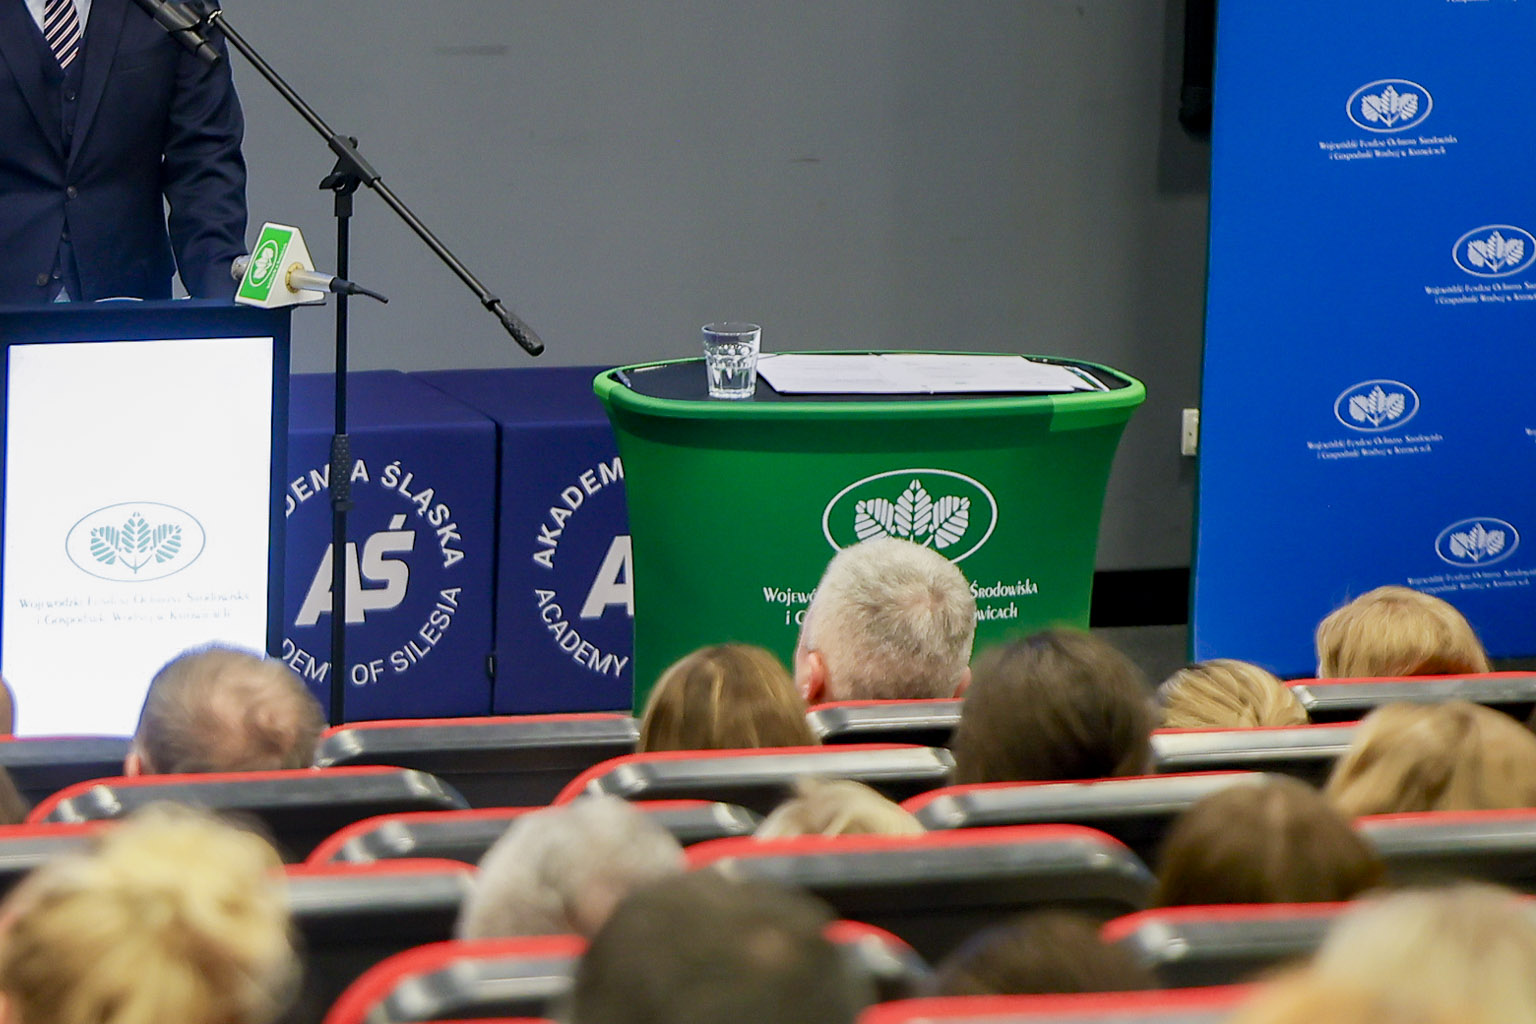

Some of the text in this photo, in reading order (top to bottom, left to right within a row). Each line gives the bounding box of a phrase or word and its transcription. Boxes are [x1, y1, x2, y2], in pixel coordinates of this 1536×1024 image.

[380, 460, 465, 569] ŚLĄSKA
[295, 514, 415, 626] AŚ
[785, 609, 791, 626] i
[973, 601, 1018, 621] wicach
[969, 578, 1039, 600] Środowiska
[351, 658, 385, 686] OF
[390, 587, 463, 673] SILESIA
[534, 588, 630, 678] ACADEMY
